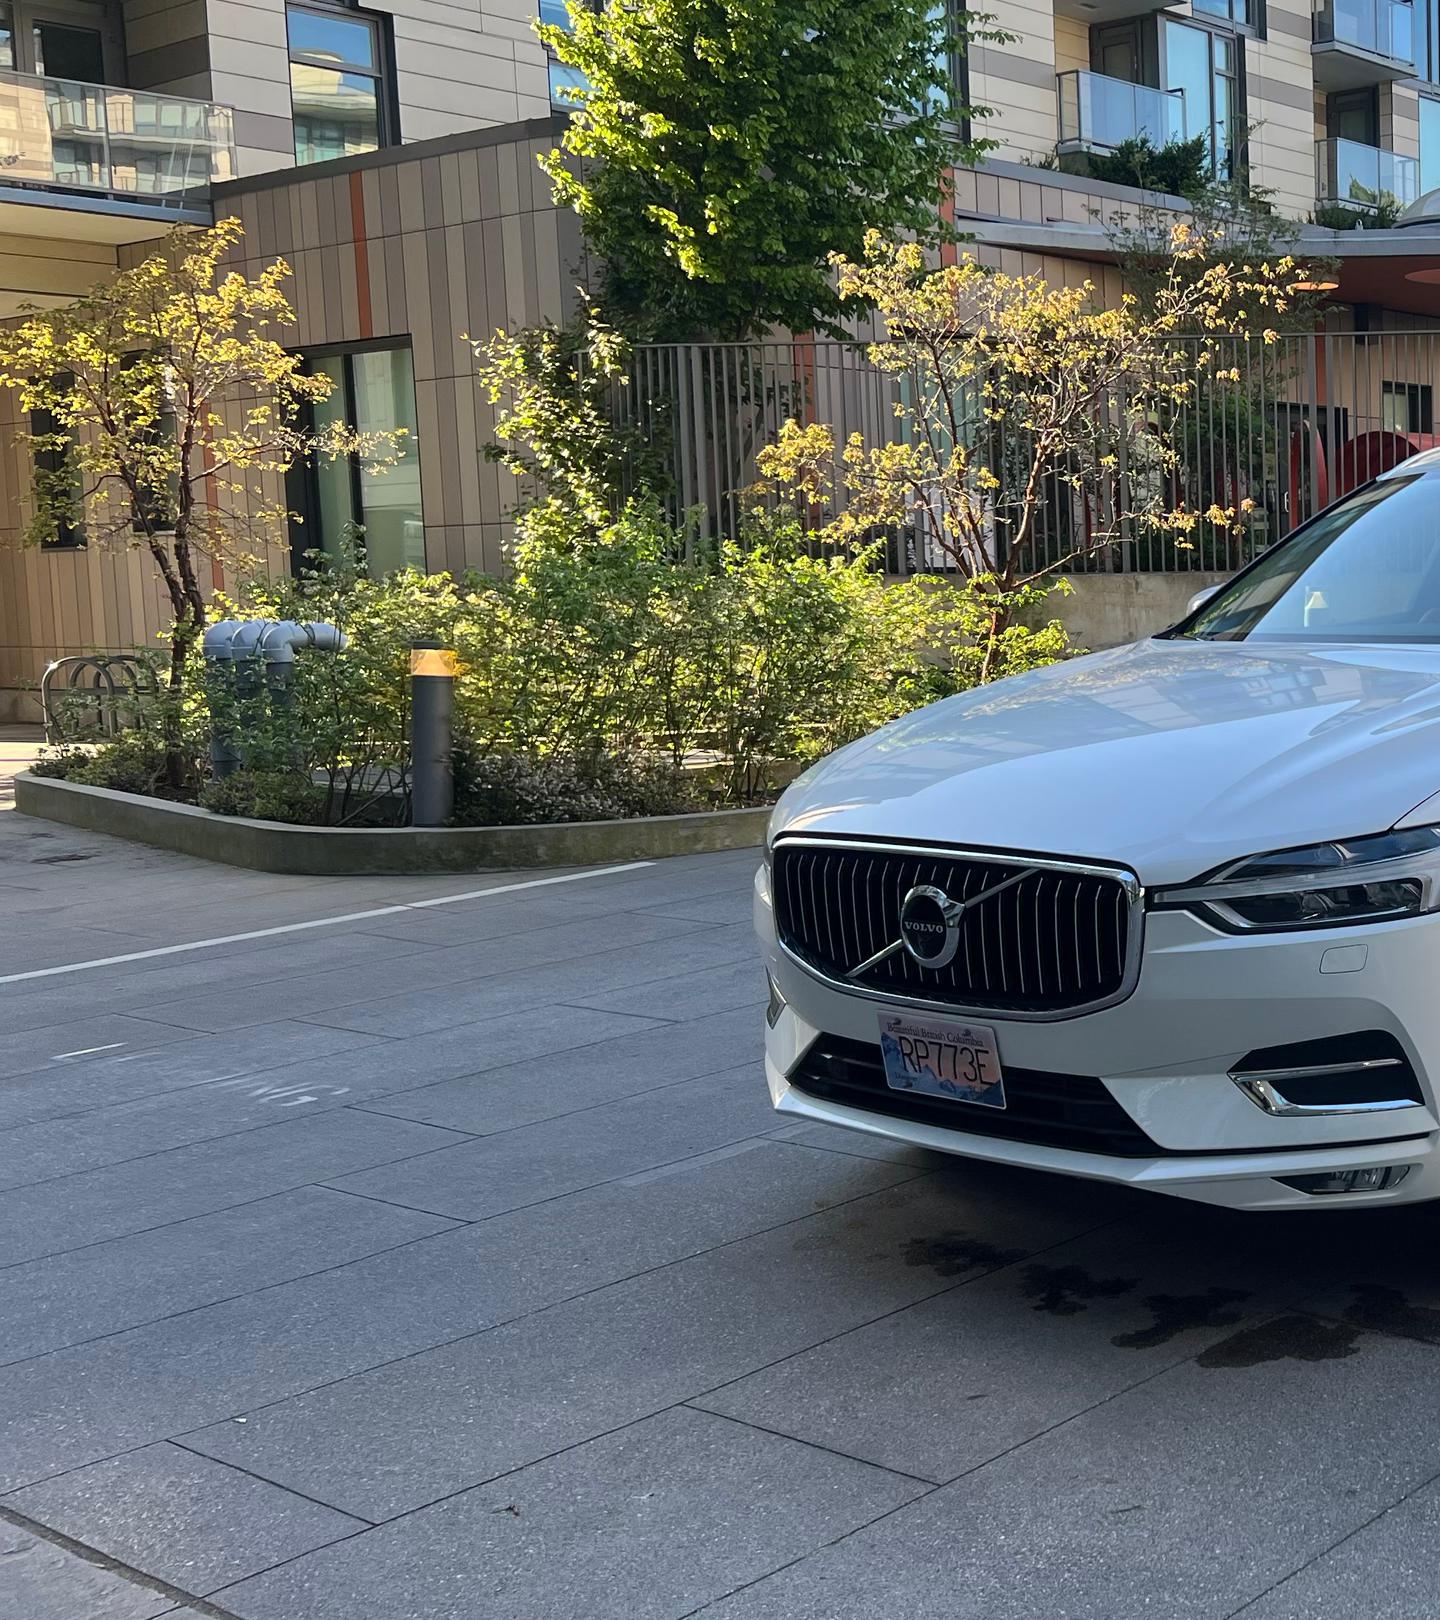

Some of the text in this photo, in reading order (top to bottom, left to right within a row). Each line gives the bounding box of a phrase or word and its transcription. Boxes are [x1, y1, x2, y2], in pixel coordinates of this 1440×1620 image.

[904, 921, 944, 933] VOLVO
[887, 1022, 984, 1047] Beautiful British Columbia
[898, 1036, 995, 1085] RP773E
